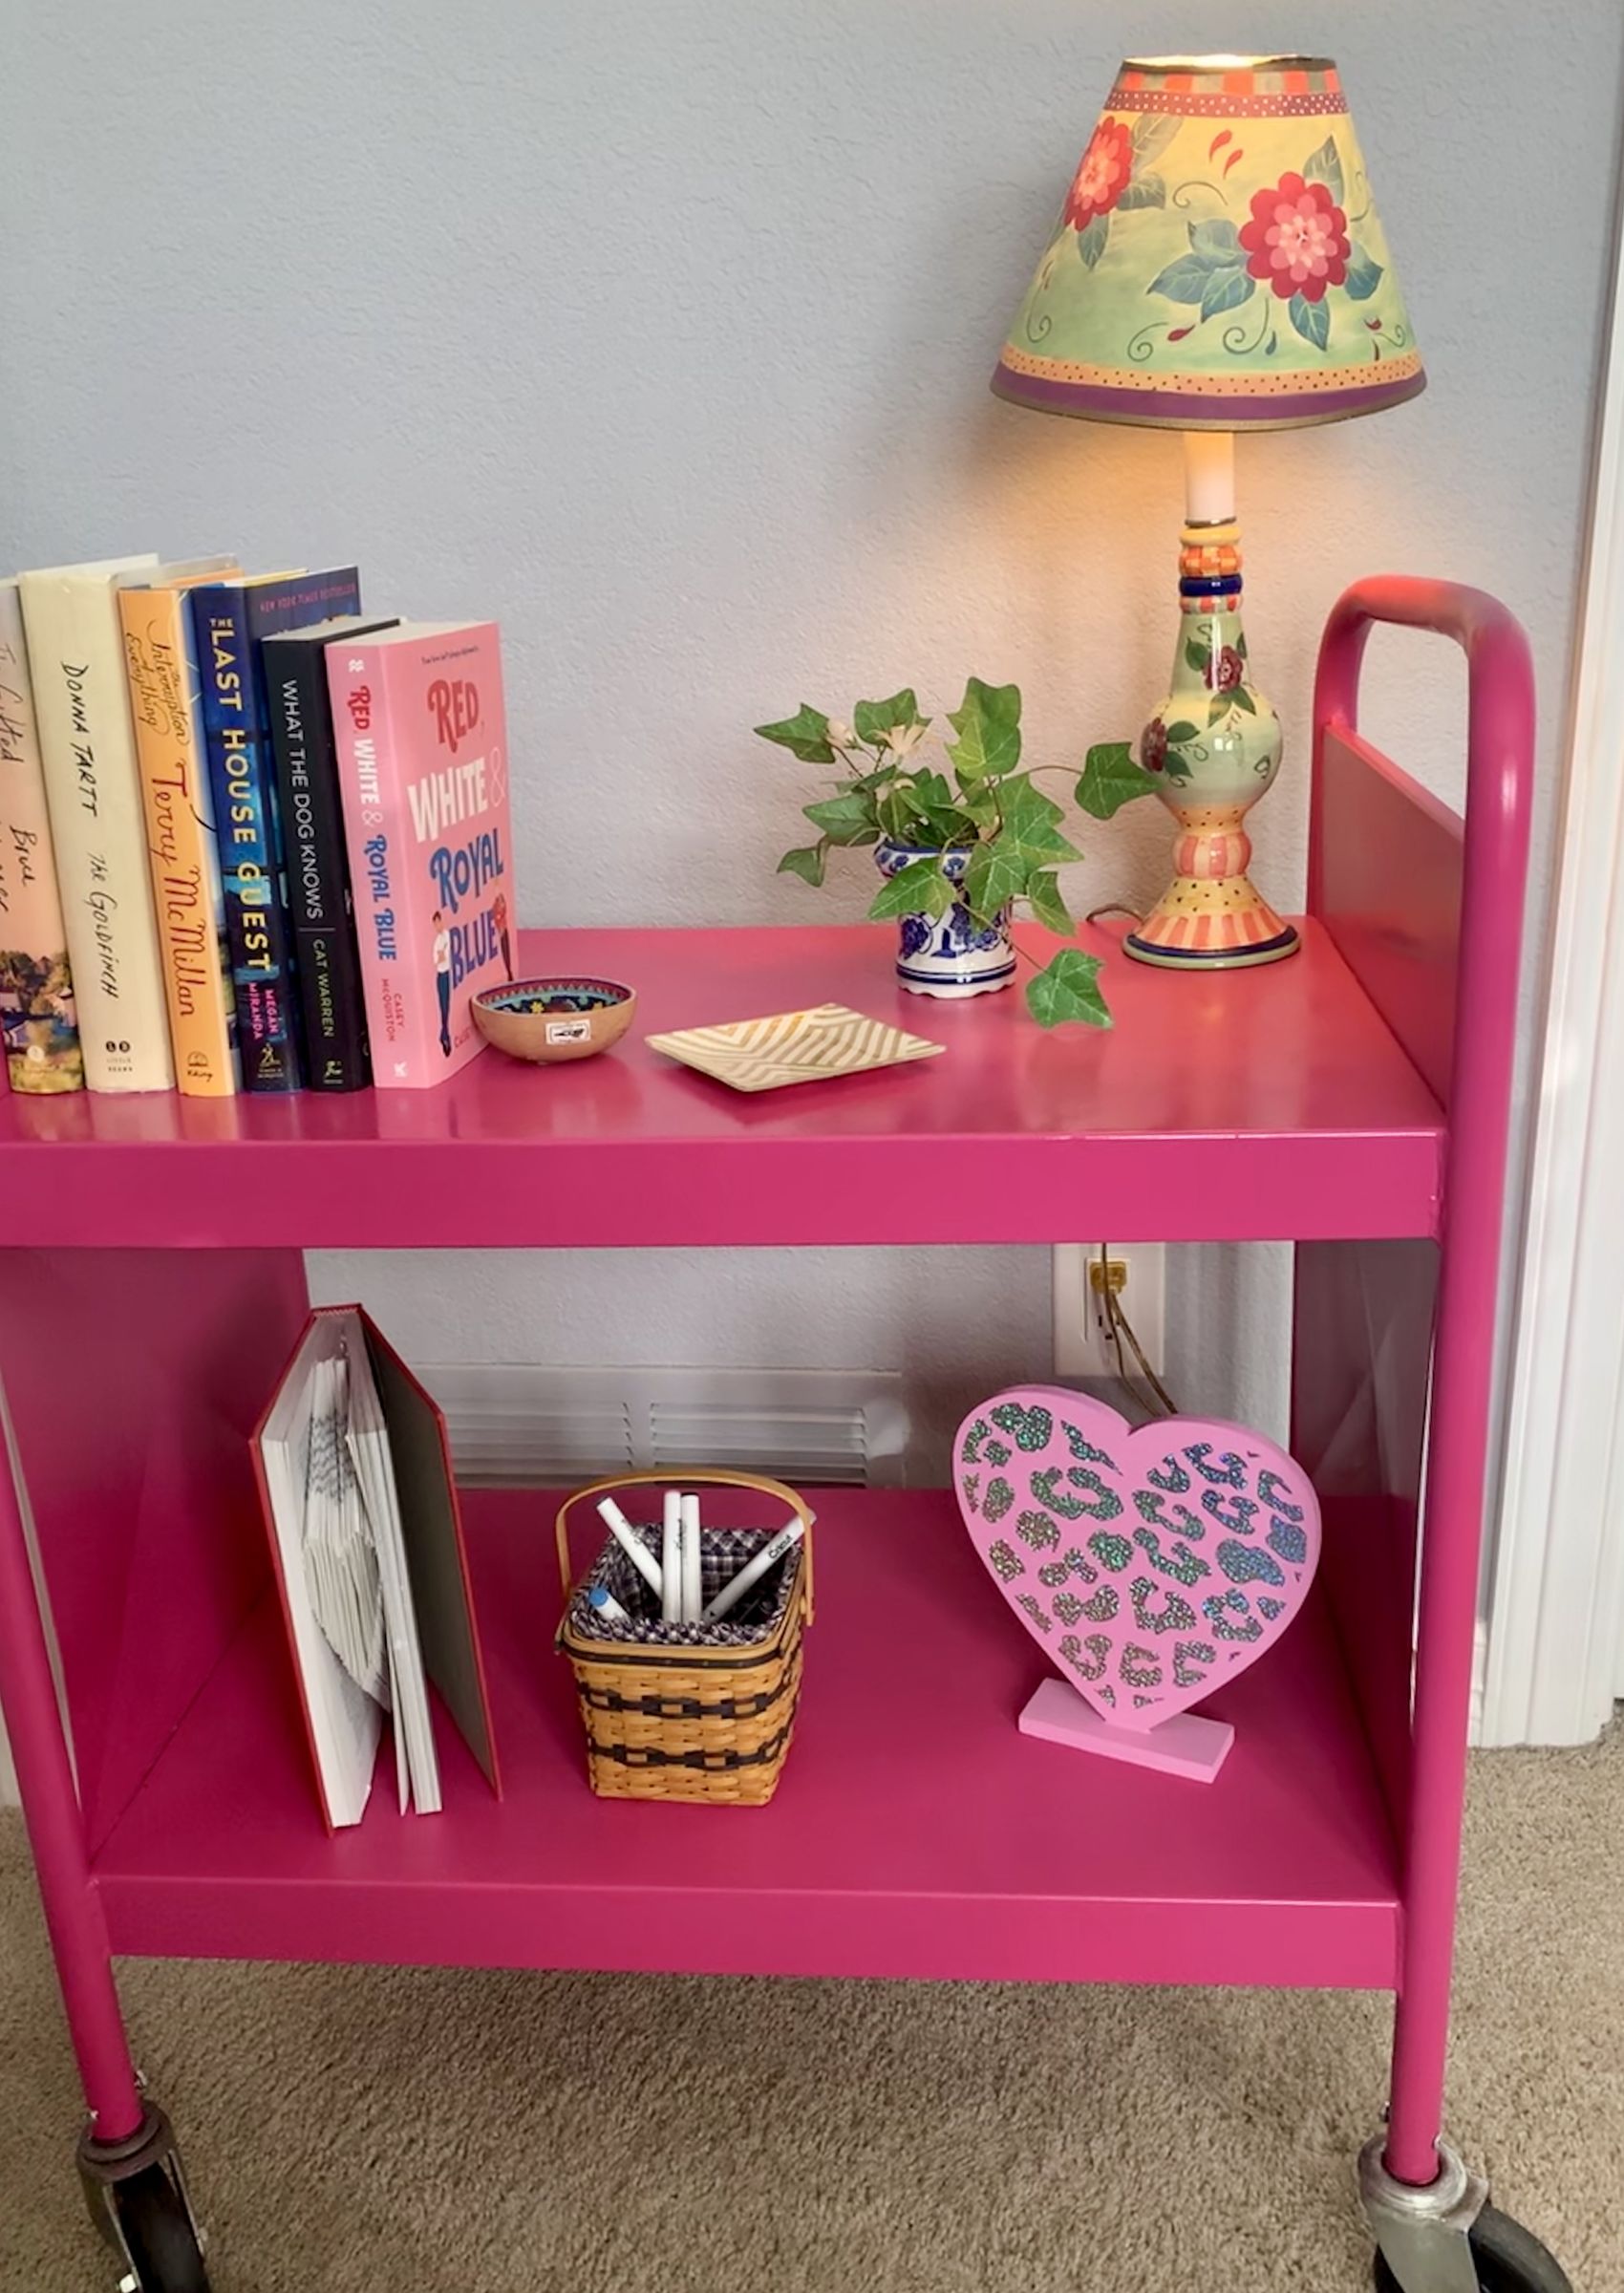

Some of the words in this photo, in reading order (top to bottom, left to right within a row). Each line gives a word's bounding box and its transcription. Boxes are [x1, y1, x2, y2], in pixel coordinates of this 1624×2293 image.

[210, 618, 234, 630] THE
[60, 660, 91, 734] DONNA
[211, 630, 243, 712] LAST
[282, 679, 305, 741] WHAT
[70, 744, 97, 817] TARTT
[223, 729, 256, 844] HOUSE
[288, 748, 310, 787] THE
[353, 739, 382, 804] WHITE
[407, 757, 489, 844] WHITE
[489, 746, 506, 807] &
[148, 757, 189, 867] Terry
[293, 793, 315, 840] DOG
[362, 810, 383, 826] &
[299, 844, 324, 919] KNOWS
[364, 834, 395, 903] ROYAL
[430, 827, 504, 914] ROYAL
[163, 865, 207, 1016] McMillan
[238, 862, 272, 973] GUEST
[374, 908, 397, 961] BLUE
[449, 908, 499, 991] BLUE
[312, 938, 328, 968] CAT
[248, 982, 264, 1039] MIRANDA
[265, 989, 280, 1034] MEGAN
[317, 970, 335, 1038] WARREN
[394, 993, 406, 1028] CASEY
